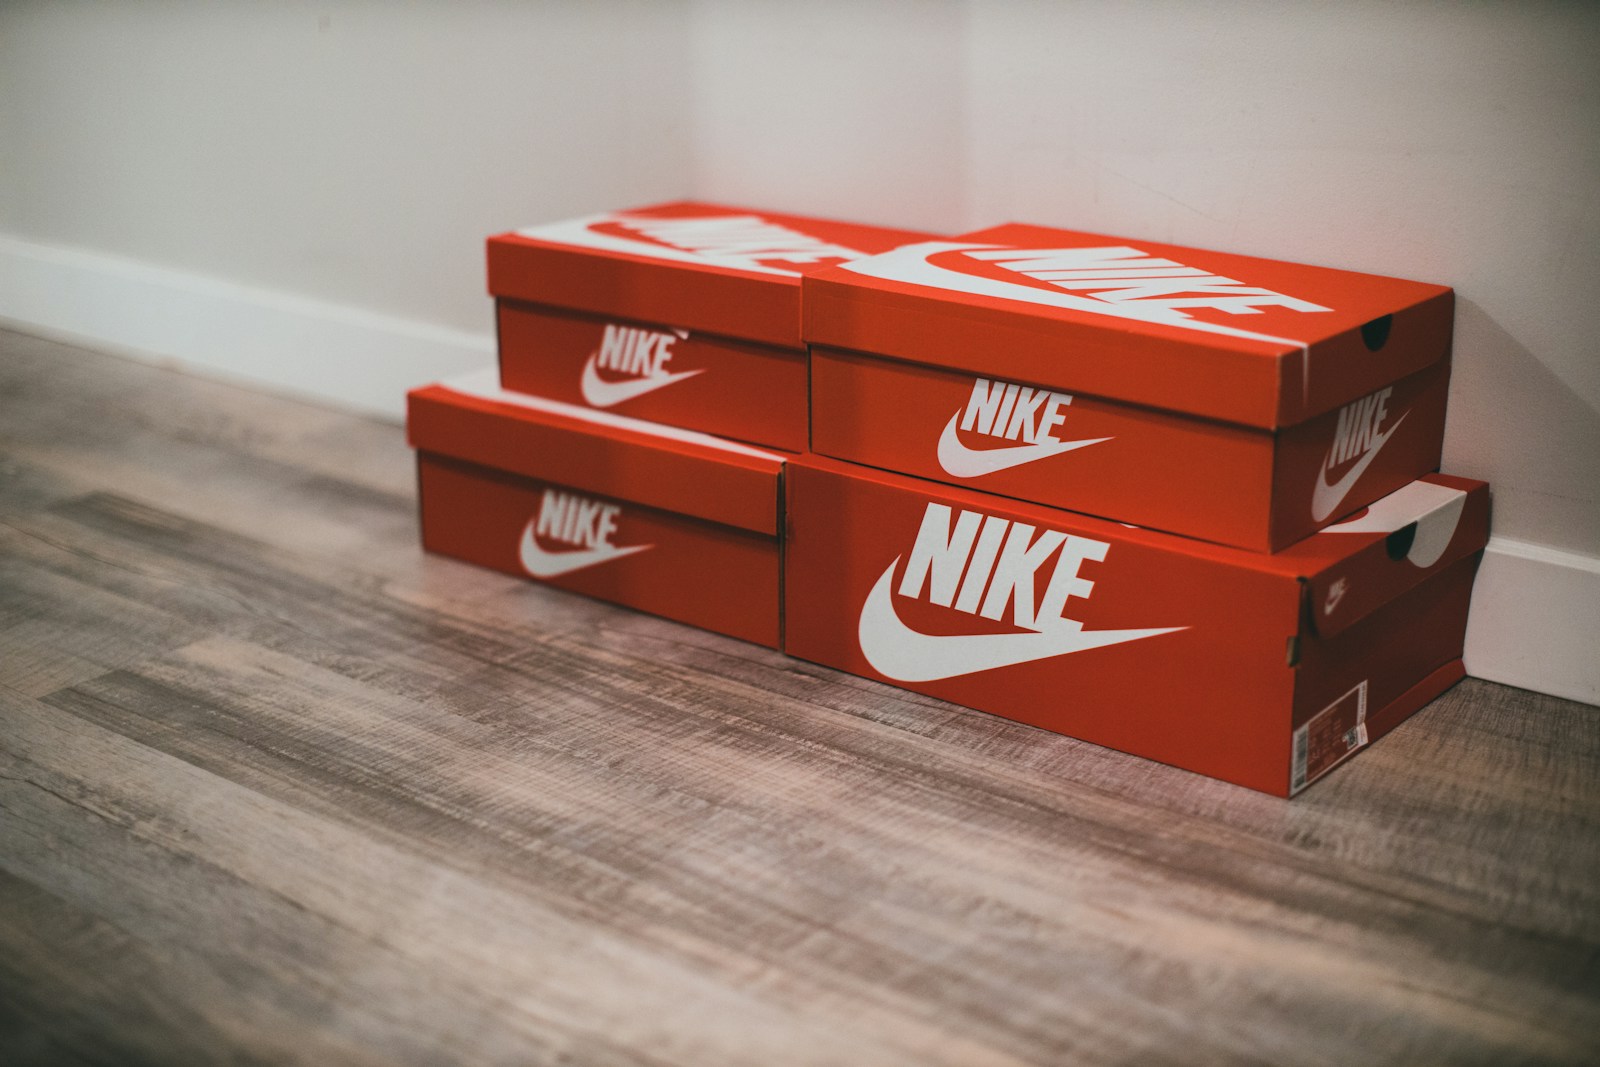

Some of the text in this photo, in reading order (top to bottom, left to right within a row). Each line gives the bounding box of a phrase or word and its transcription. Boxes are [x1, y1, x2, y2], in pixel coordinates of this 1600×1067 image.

[962, 246, 1334, 319] NIKE
[597, 324, 677, 378] NIKE
[960, 378, 1073, 444] NIKE
[1328, 386, 1393, 469] NIKE
[537, 490, 621, 549] NIKE
[898, 502, 1111, 632] NIKE
